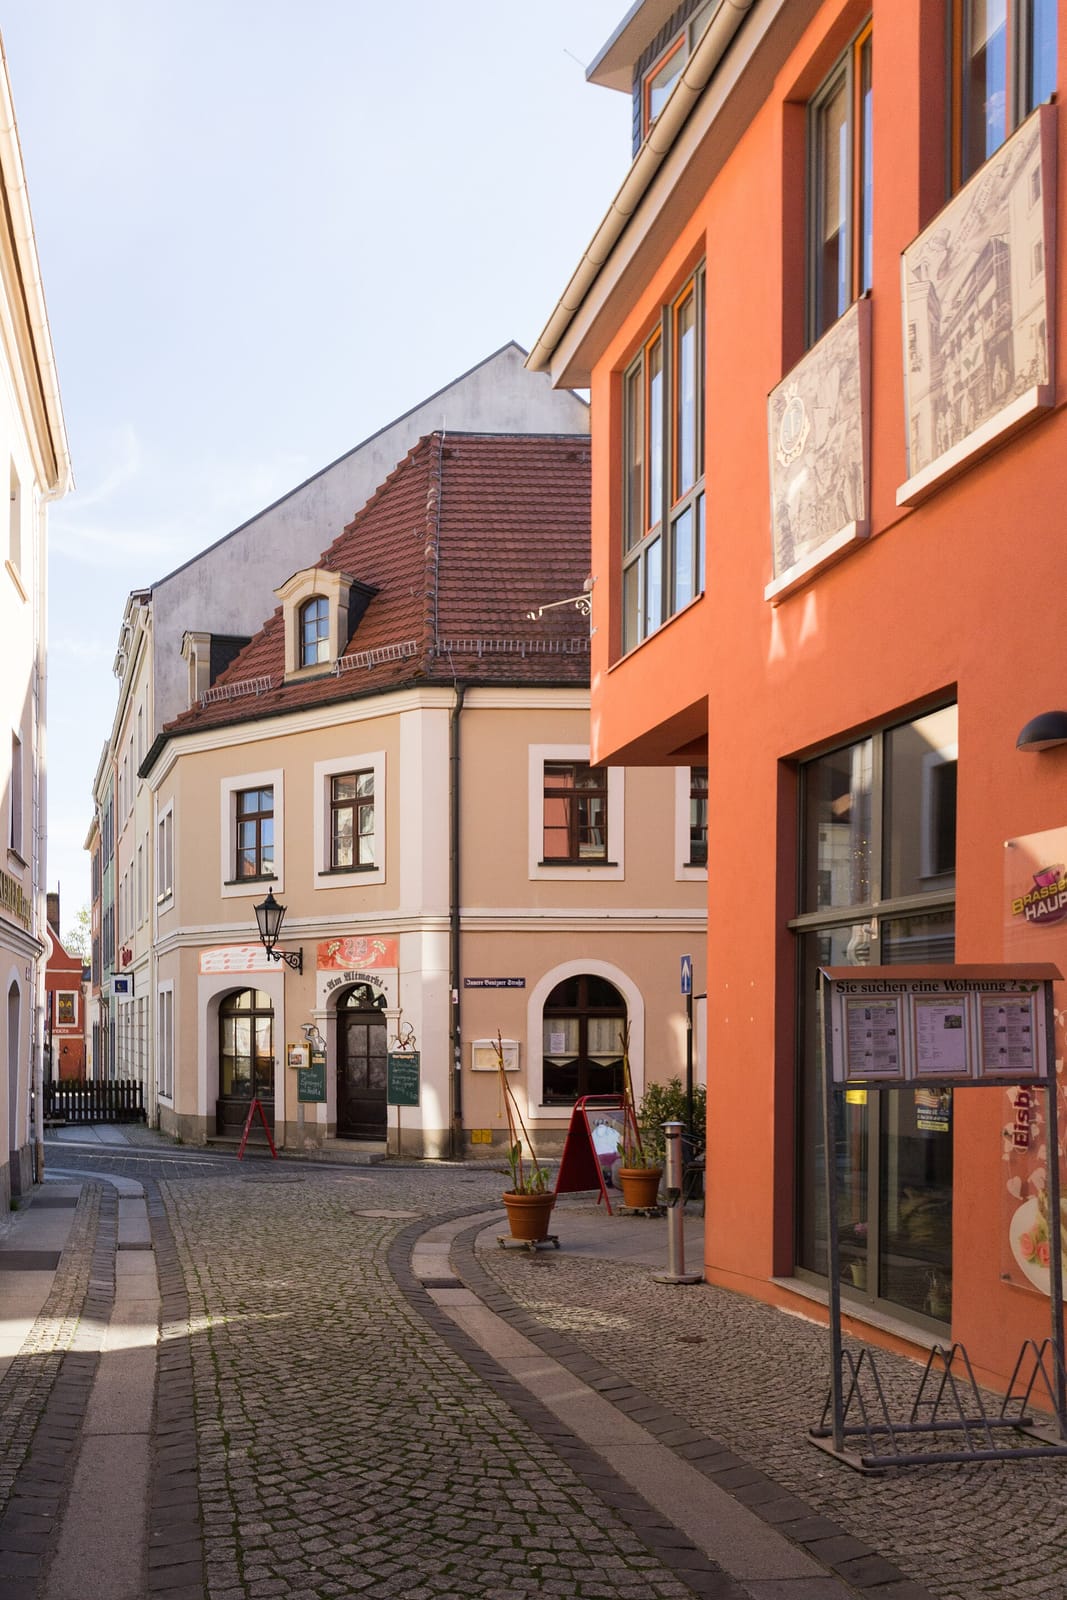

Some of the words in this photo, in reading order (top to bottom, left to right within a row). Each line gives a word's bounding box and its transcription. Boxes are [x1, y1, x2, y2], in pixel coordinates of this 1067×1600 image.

[1011, 879, 1067, 915] BRASSe
[326, 977, 343, 990] Am
[344, 970, 384, 988] Altmarkt
[836, 981, 857, 993] Sie
[861, 980, 907, 993] suchen
[911, 981, 939, 993] eine
[943, 980, 1006, 993] Wohnung
